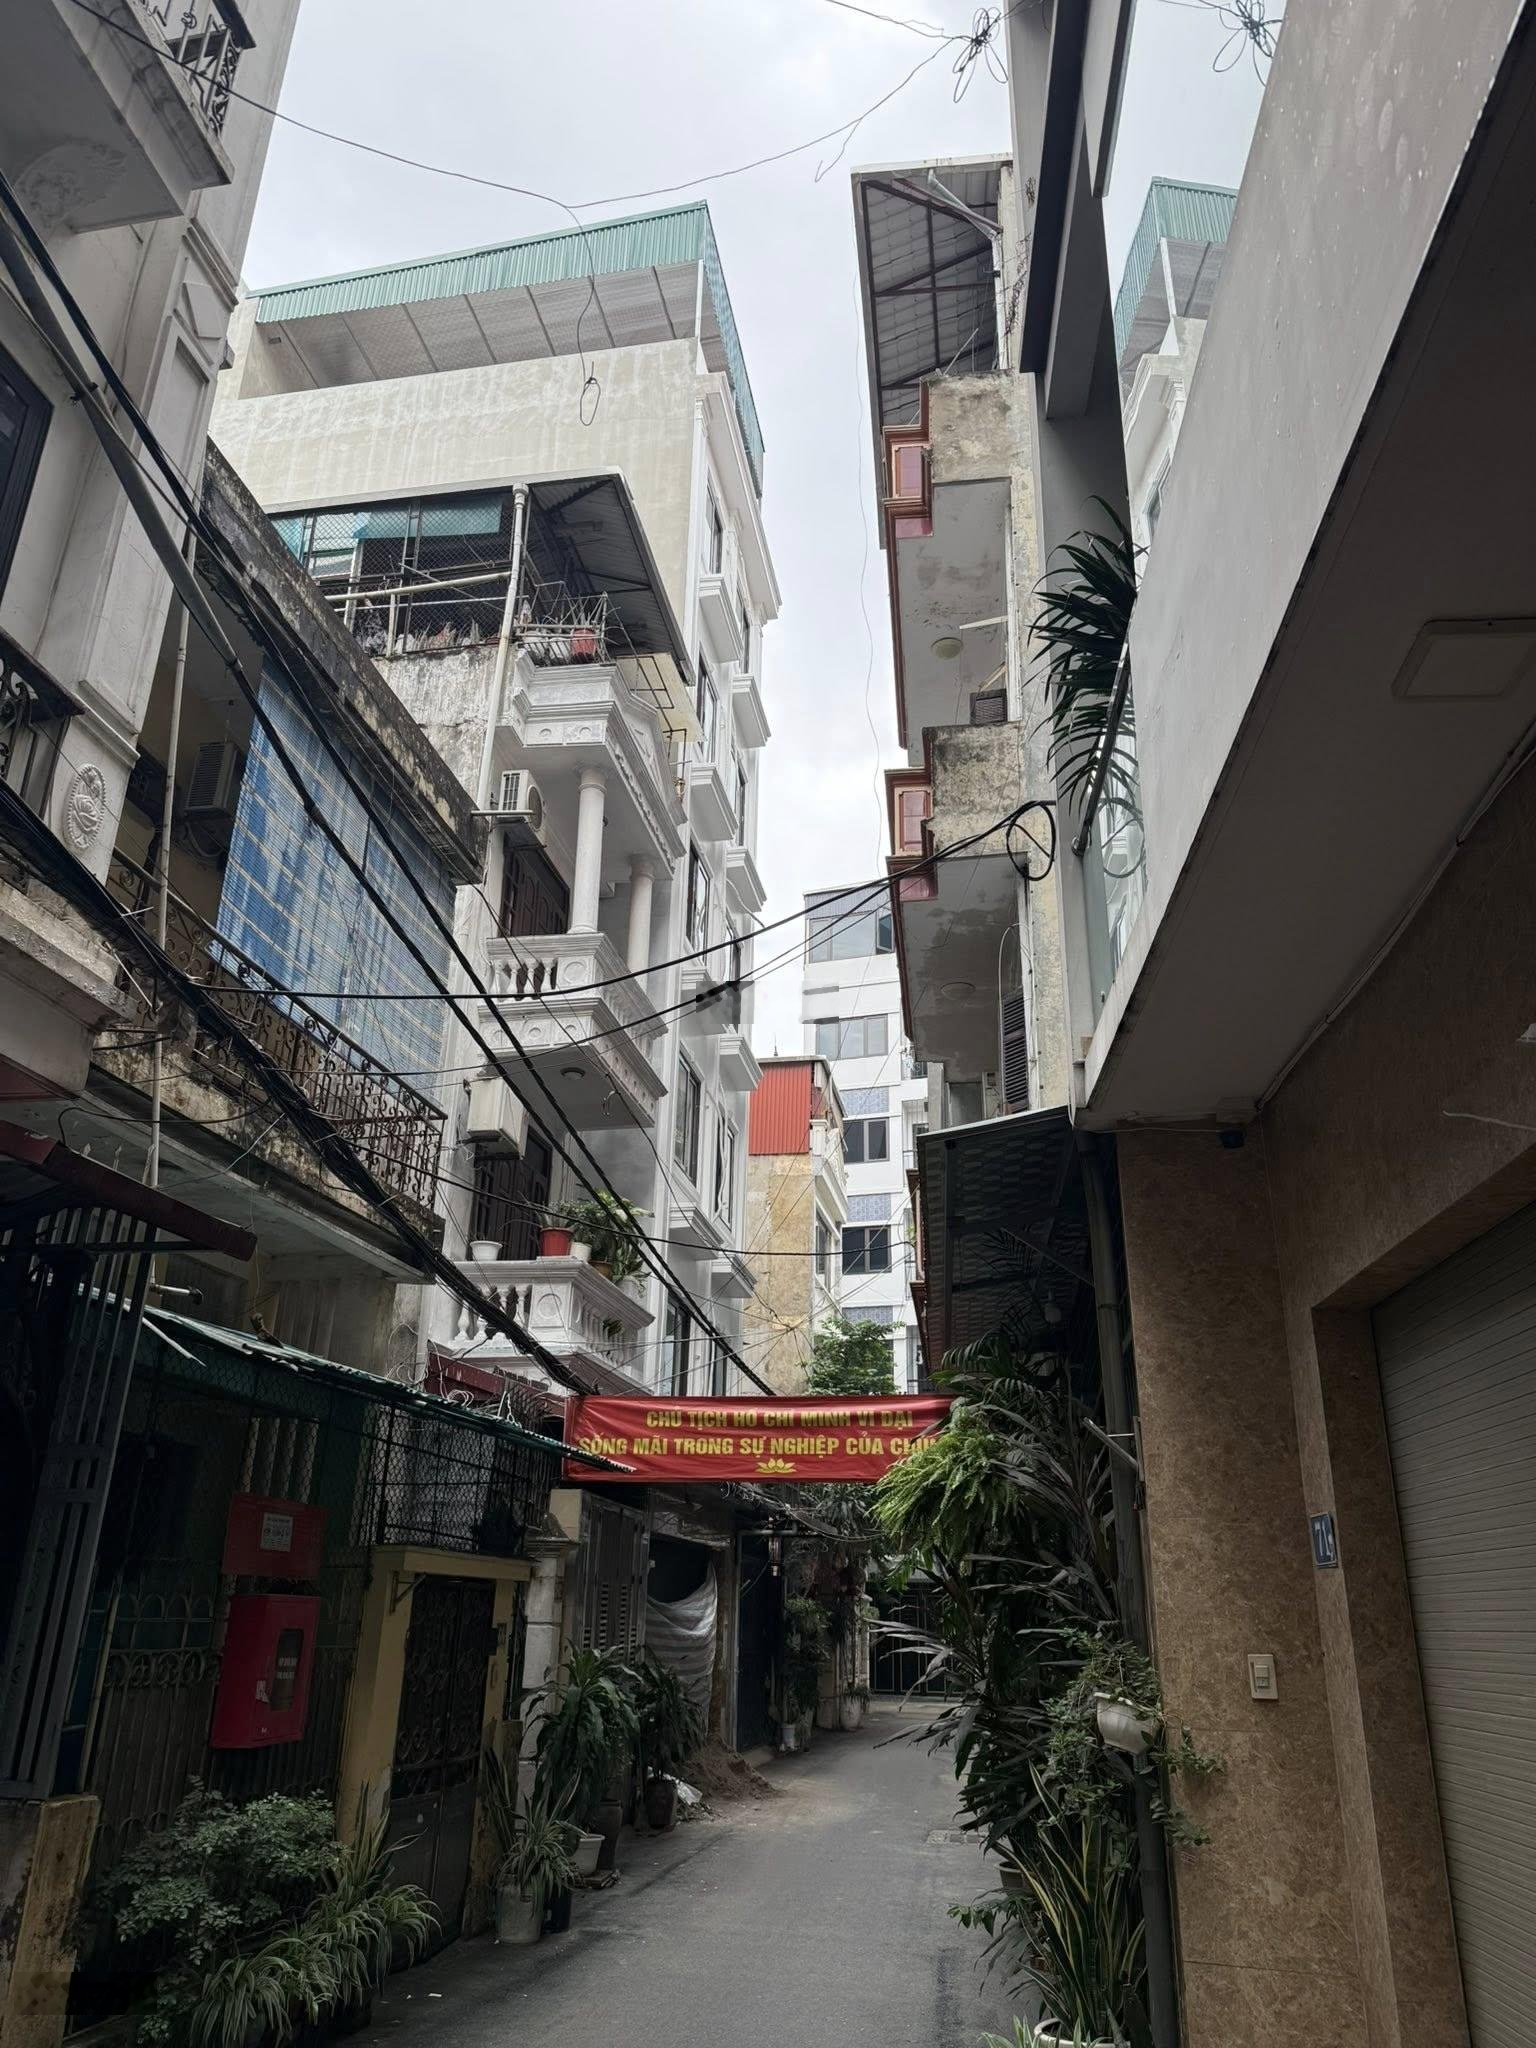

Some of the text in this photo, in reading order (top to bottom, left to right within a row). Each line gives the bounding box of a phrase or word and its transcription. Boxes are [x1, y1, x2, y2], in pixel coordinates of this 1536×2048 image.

[688, 1410, 728, 1430] TỊCH
[800, 1410, 851, 1428] MINH
[577, 1432, 628, 1456] SỐNG
[632, 1434, 668, 1456] MÃI
[673, 1437, 734, 1456] TRONG
[739, 1435, 768, 1459] SỰ
[770, 1434, 839, 1459] NGHIỆP
[845, 1430, 885, 1456] CỦA
